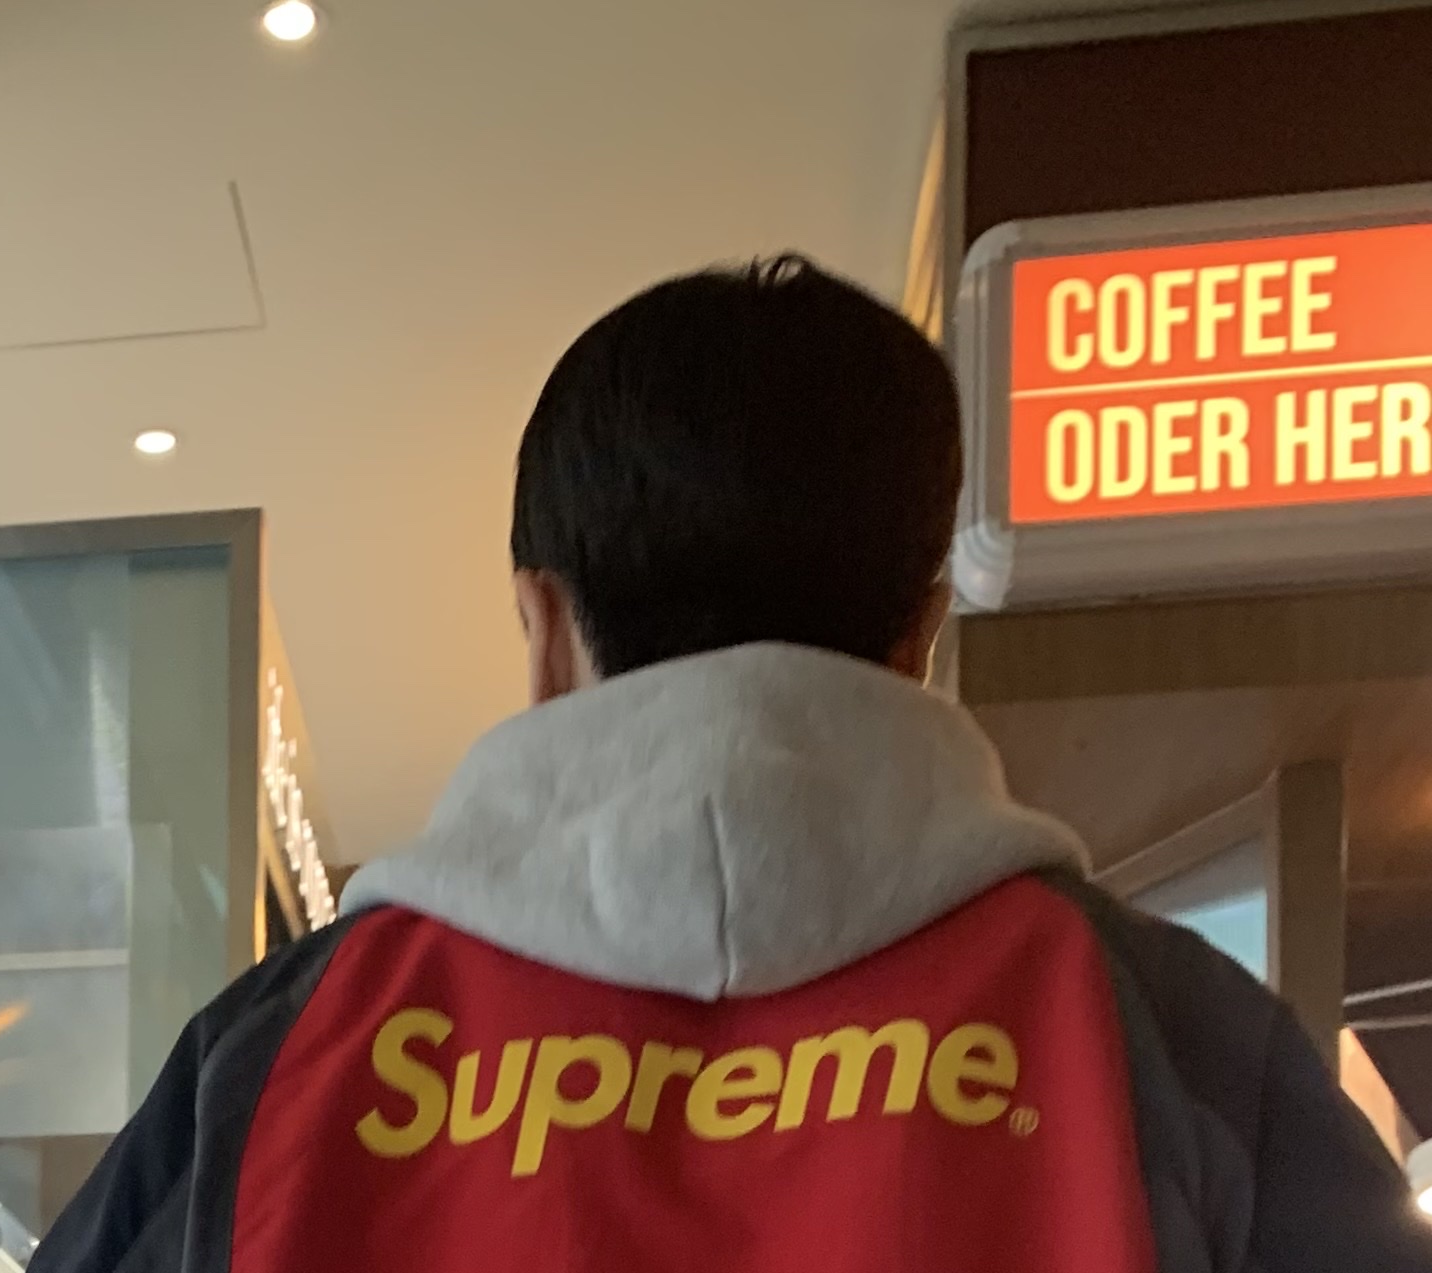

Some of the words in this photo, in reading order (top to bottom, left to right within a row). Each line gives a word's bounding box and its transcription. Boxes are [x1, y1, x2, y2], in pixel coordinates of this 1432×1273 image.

[1046, 255, 1338, 373] COFFEE
[1044, 396, 1250, 504] ODER
[1274, 380, 1432, 486] HER
[355, 1006, 1020, 1179] Supreme
